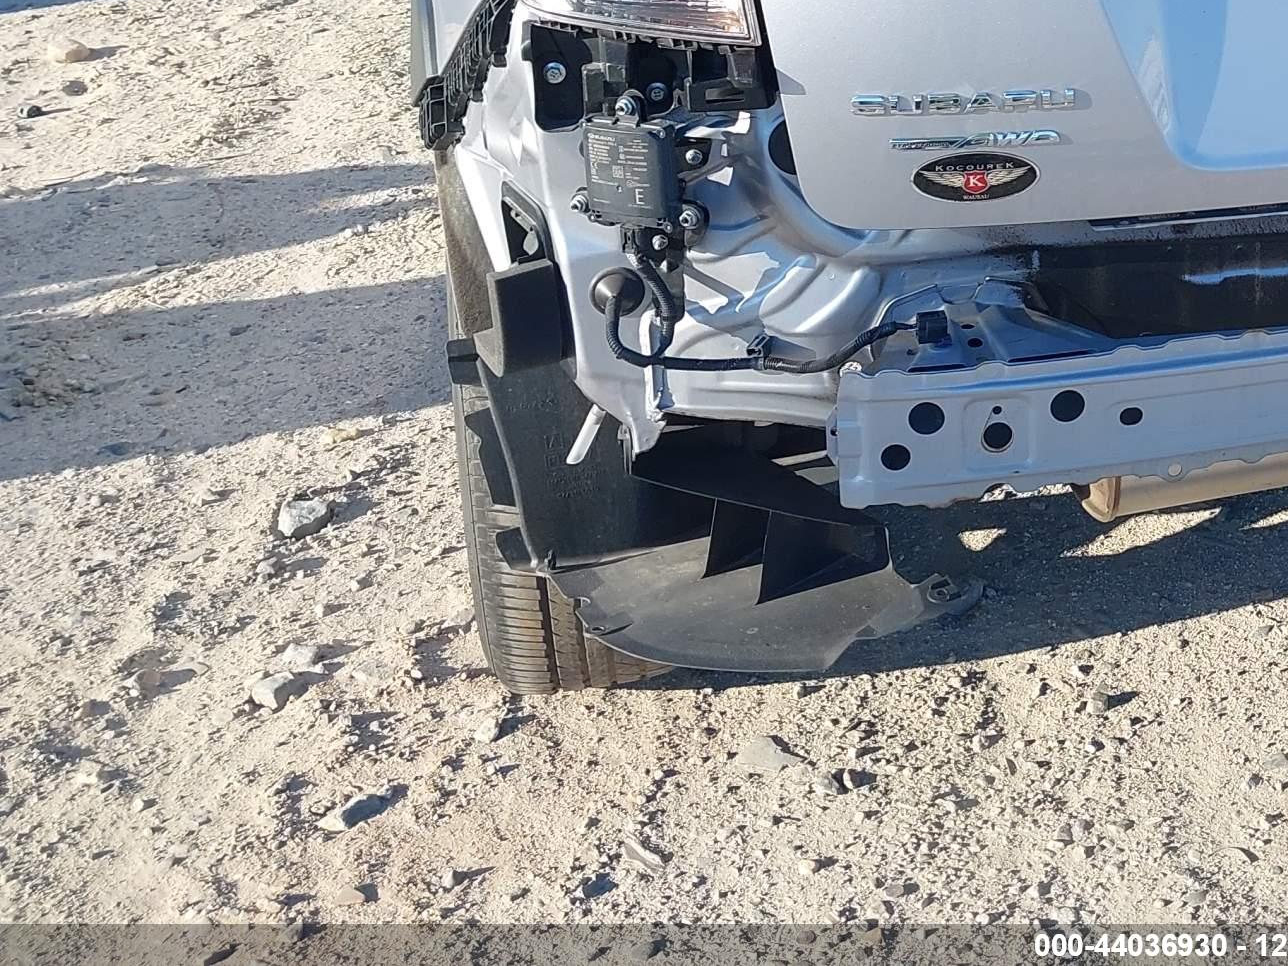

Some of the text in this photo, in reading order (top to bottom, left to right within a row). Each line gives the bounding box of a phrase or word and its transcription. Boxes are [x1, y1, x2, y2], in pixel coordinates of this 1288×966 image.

[850, 87, 1077, 116] SUBARU
[935, 161, 1015, 172] KOCOUREK
[968, 173, 985, 187] K
[635, 188, 645, 204] E
